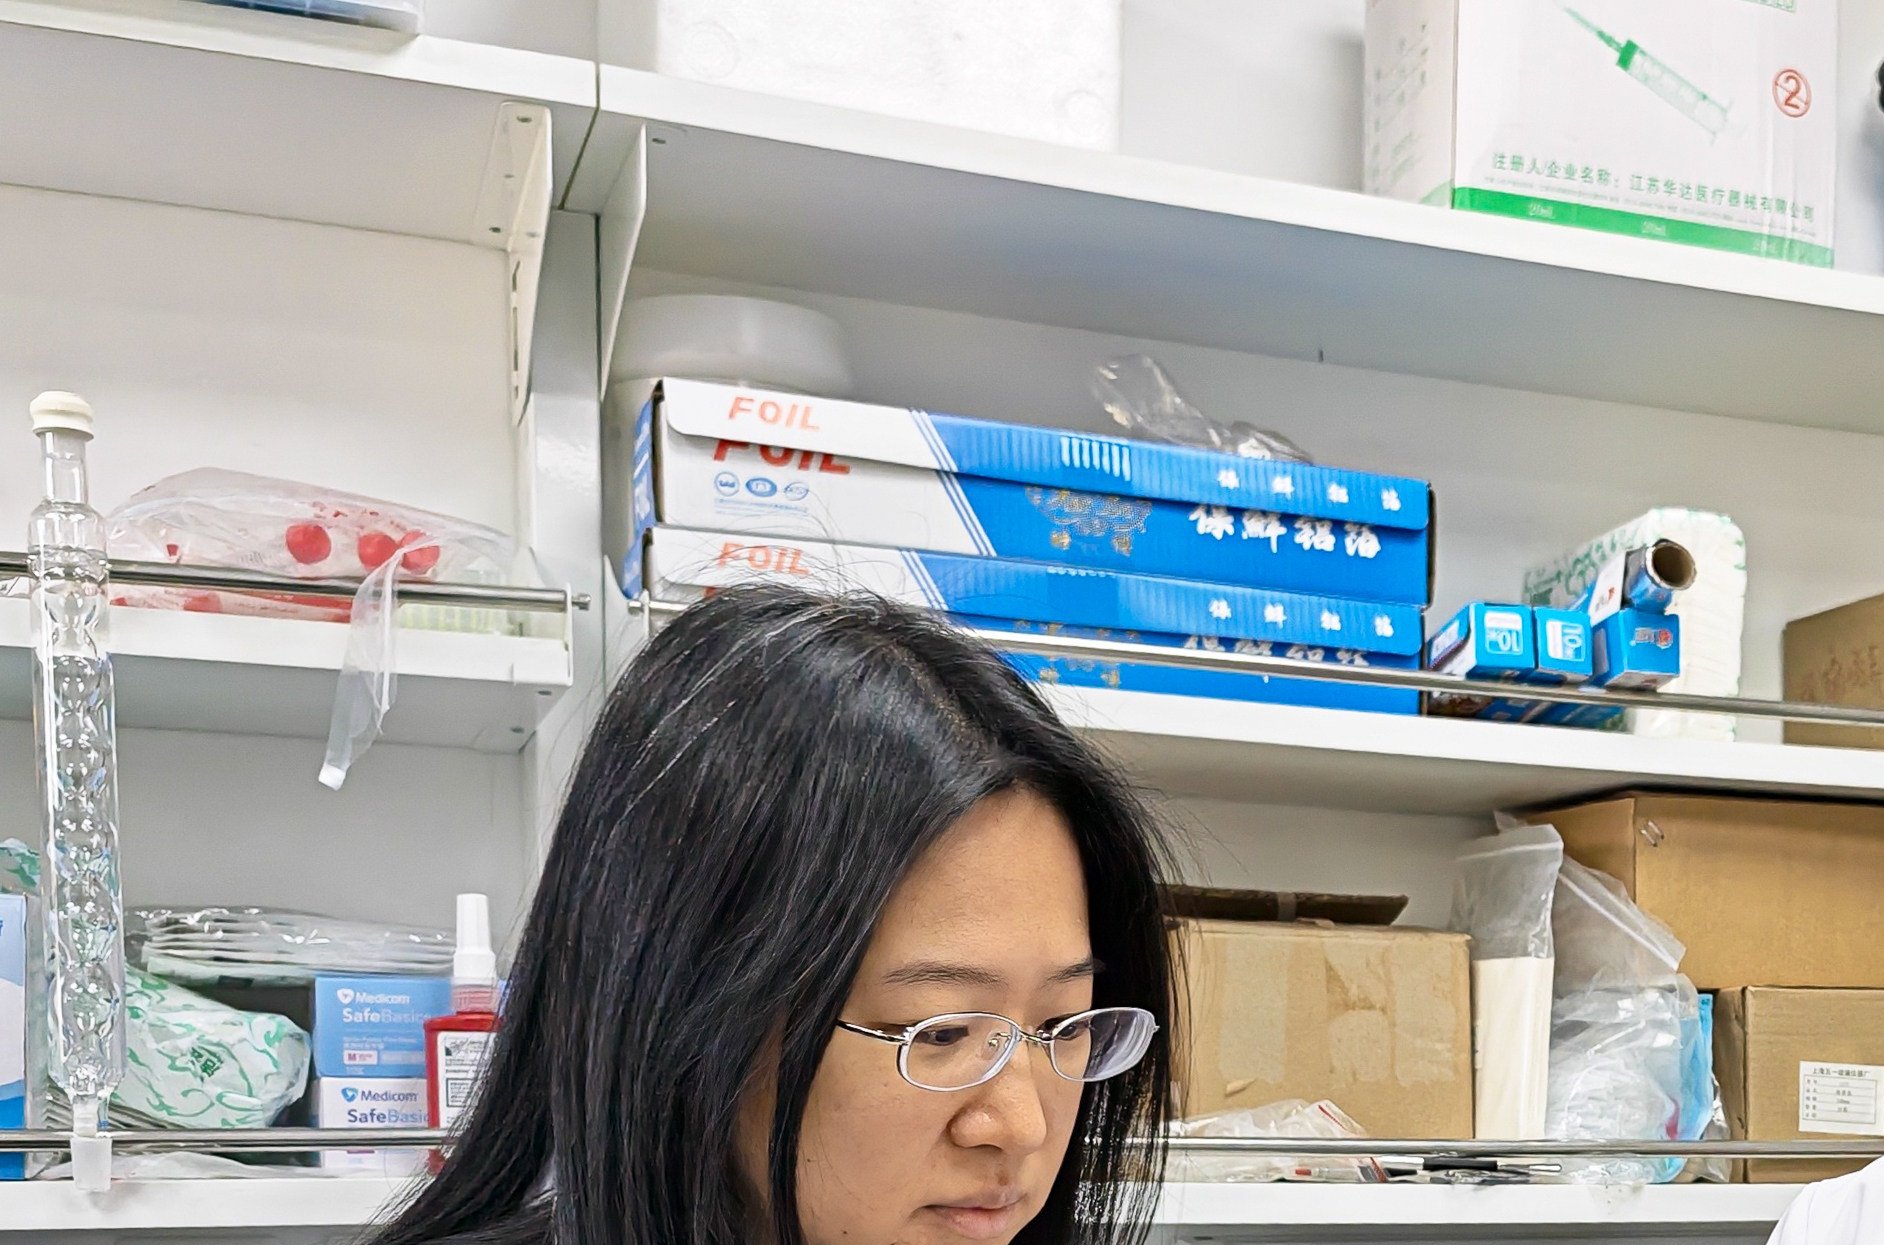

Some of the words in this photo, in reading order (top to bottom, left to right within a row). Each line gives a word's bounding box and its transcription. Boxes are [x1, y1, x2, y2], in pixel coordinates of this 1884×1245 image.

[728, 396, 820, 431] FOIL
[716, 542, 811, 578] FOIL
[355, 992, 411, 1005] Medicom
[361, 1090, 419, 1102] Medicom
[347, 1107, 430, 1124] SafeBasic
